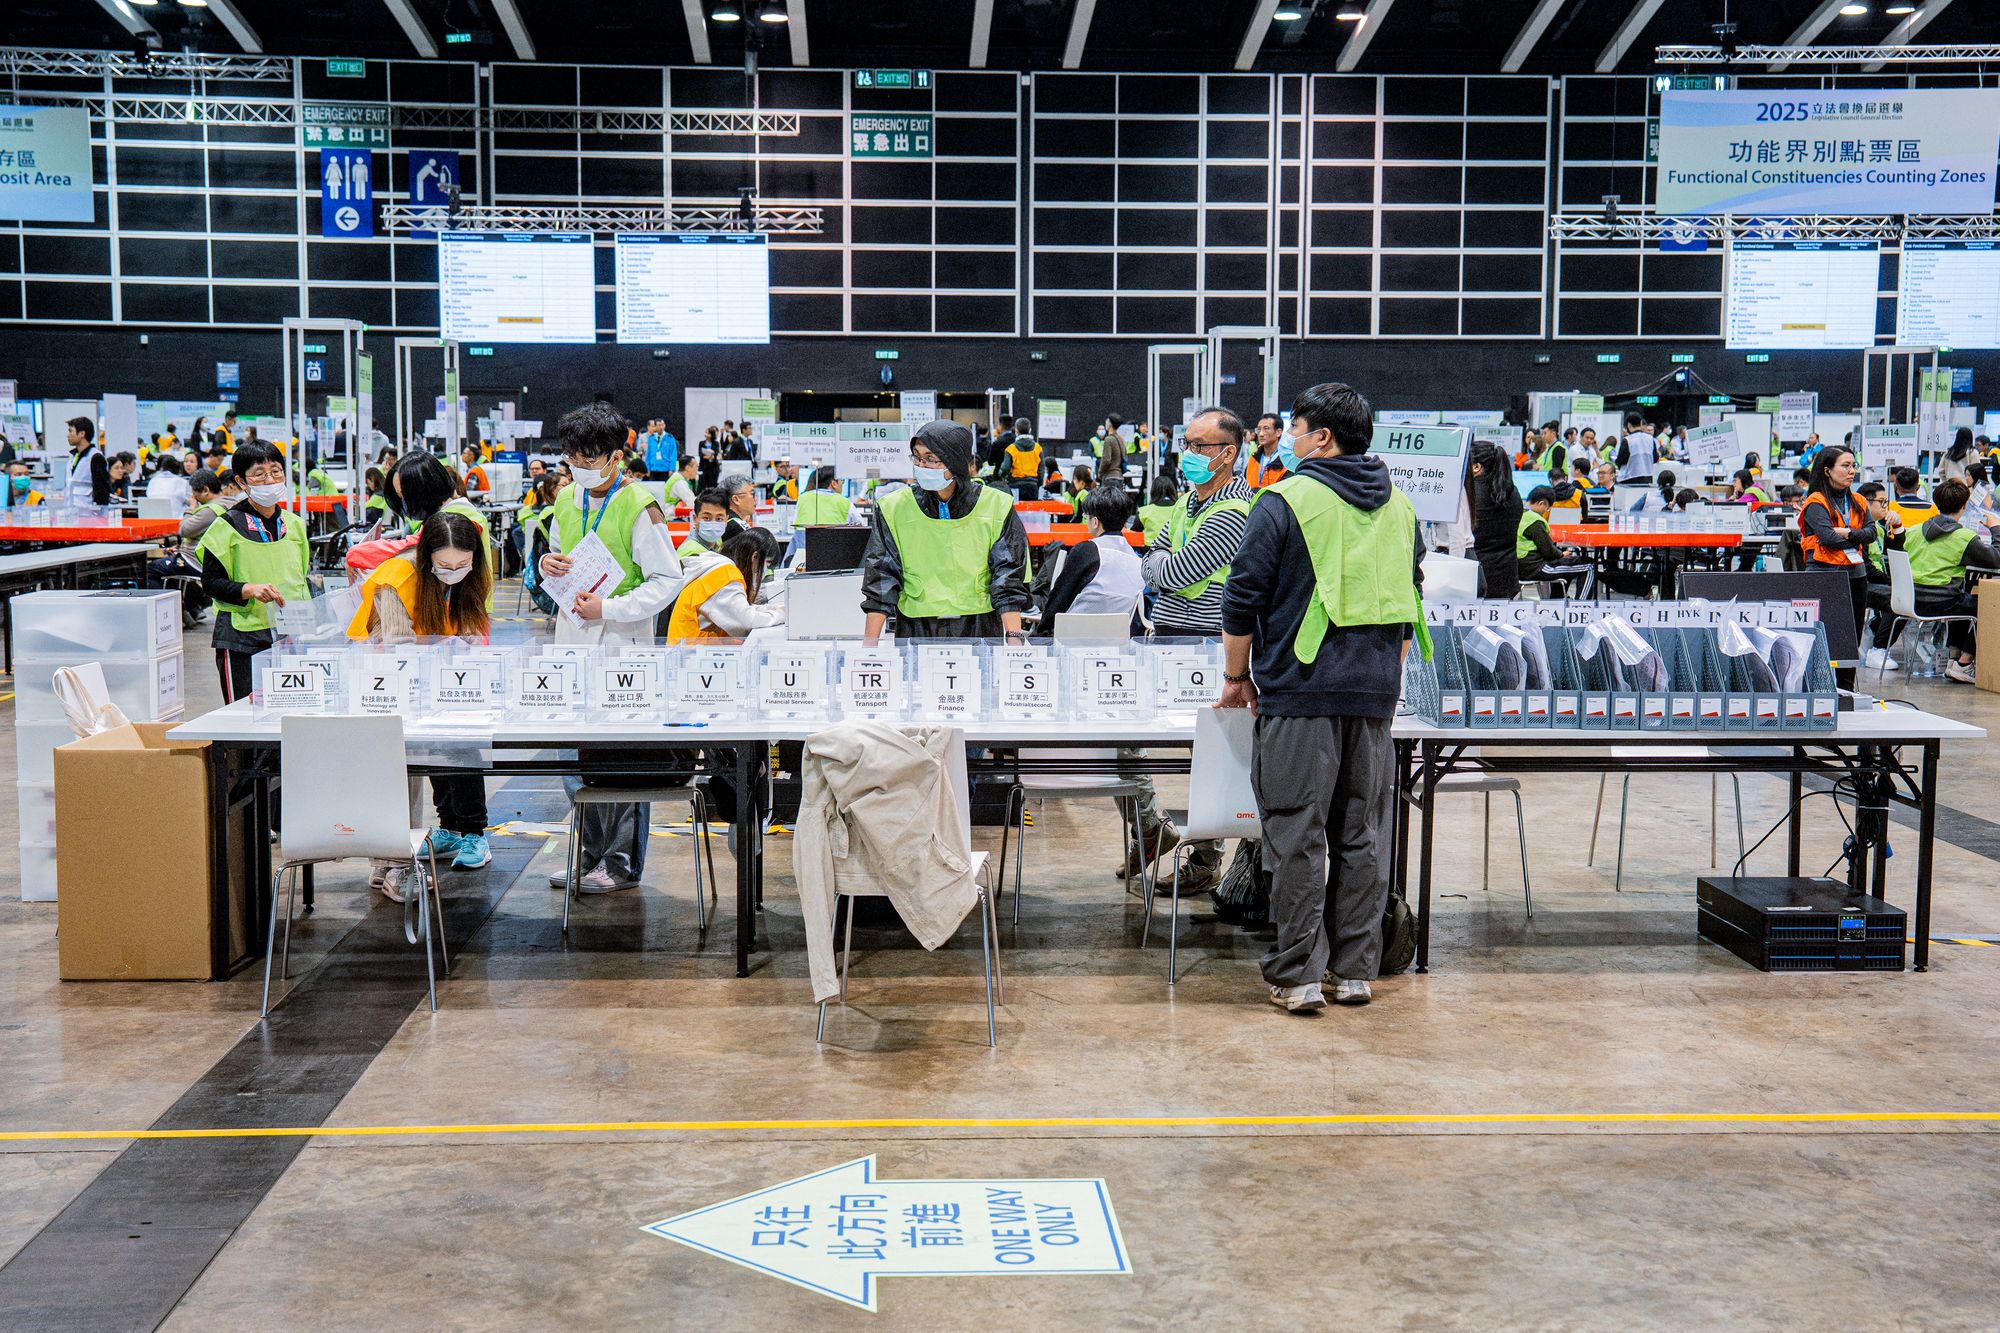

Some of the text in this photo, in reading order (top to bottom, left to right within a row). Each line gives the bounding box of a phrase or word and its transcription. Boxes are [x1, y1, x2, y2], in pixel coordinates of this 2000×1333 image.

[330, 63, 350, 72] EXIT
[878, 74, 895, 84] EXIT
[305, 107, 386, 121] EMERGENCY EXIT
[1756, 102, 1903, 122] 2025 立法會換屆選舉
[852, 118, 930, 132] EMERGENCY EXIT
[853, 133, 929, 152] 緊急出口
[1728, 139, 1921, 164] 功能界別點票區
[34, 172, 72, 186] Area
[1668, 170, 1986, 186] Functional Constituencies Counting Zones
[863, 428, 887, 438] H16
[1702, 427, 1718, 436] H14
[1388, 432, 1424, 450] H16
[1390, 466, 1444, 478] rting Table
[1427, 610, 1437, 621] A
[1456, 610, 1478, 621] AF
[1489, 610, 1499, 621] B
[1514, 609, 1525, 620] C
[1569, 612, 1589, 623] DE
[1630, 612, 1641, 623] G
[1658, 611, 1668, 622] H
[1740, 611, 1750, 623] K
[1769, 612, 1777, 622] L
[1794, 611, 1808, 622] M
[281, 674, 305, 688] ZN
[373, 678, 385, 691] Z
[455, 672, 466, 686] Y
[537, 676, 548, 689] X
[617, 674, 634, 687] W
[701, 675, 712, 688] V
[784, 673, 795, 686] U
[859, 674, 882, 687] TR
[946, 676, 957, 689] T
[1023, 676, 1034, 689] S
[1111, 674, 1122, 687] R
[1191, 672, 1204, 686] Q
[608, 693, 644, 702] 進出口界
[938, 695, 964, 704] 金融界
[752, 1204, 811, 1248] 只往
[826, 1194, 889, 1261] 此方向
[901, 1202, 964, 1248] 前進
[985, 1187, 1036, 1264] ONE WAY
[1034, 1203, 1080, 1246] ONLY
